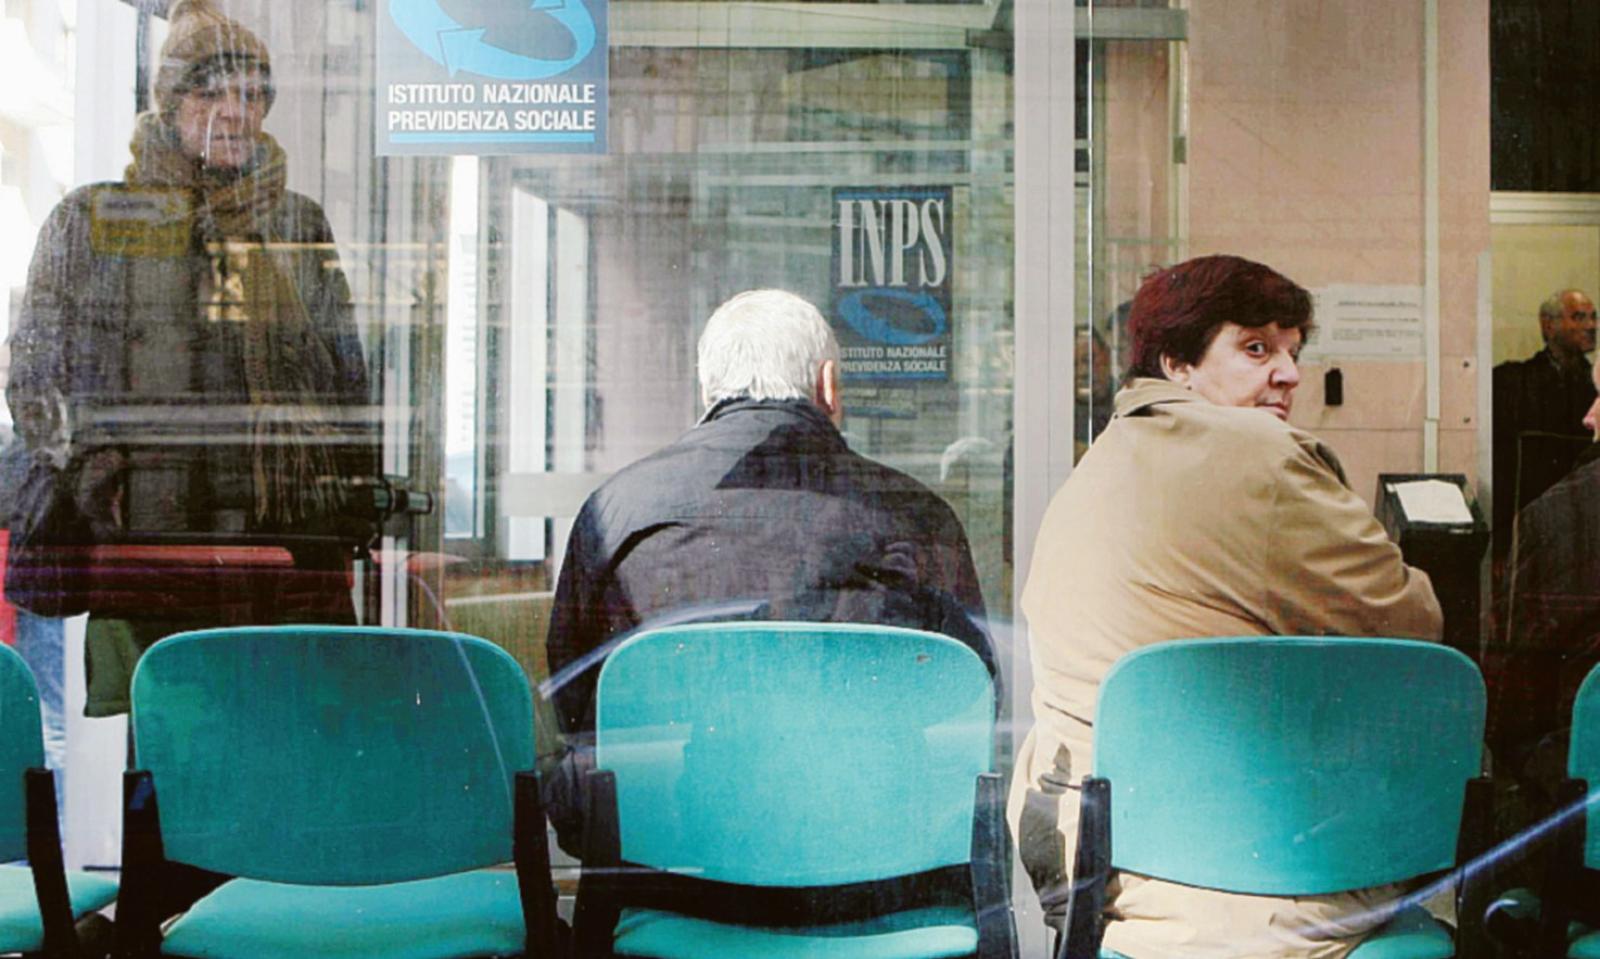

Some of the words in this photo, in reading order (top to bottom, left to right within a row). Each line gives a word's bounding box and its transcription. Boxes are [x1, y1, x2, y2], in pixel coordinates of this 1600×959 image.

[388, 84, 475, 104] ISTITUTO
[483, 84, 596, 104] NAZIONALE
[388, 110, 509, 131] PREVIDENZA
[514, 110, 596, 131] SOCIALE
[837, 198, 947, 288] INPS
[839, 346, 884, 358] STITUTO
[886, 345, 946, 358] NAZIONALE
[903, 360, 946, 372] SOCIALE
